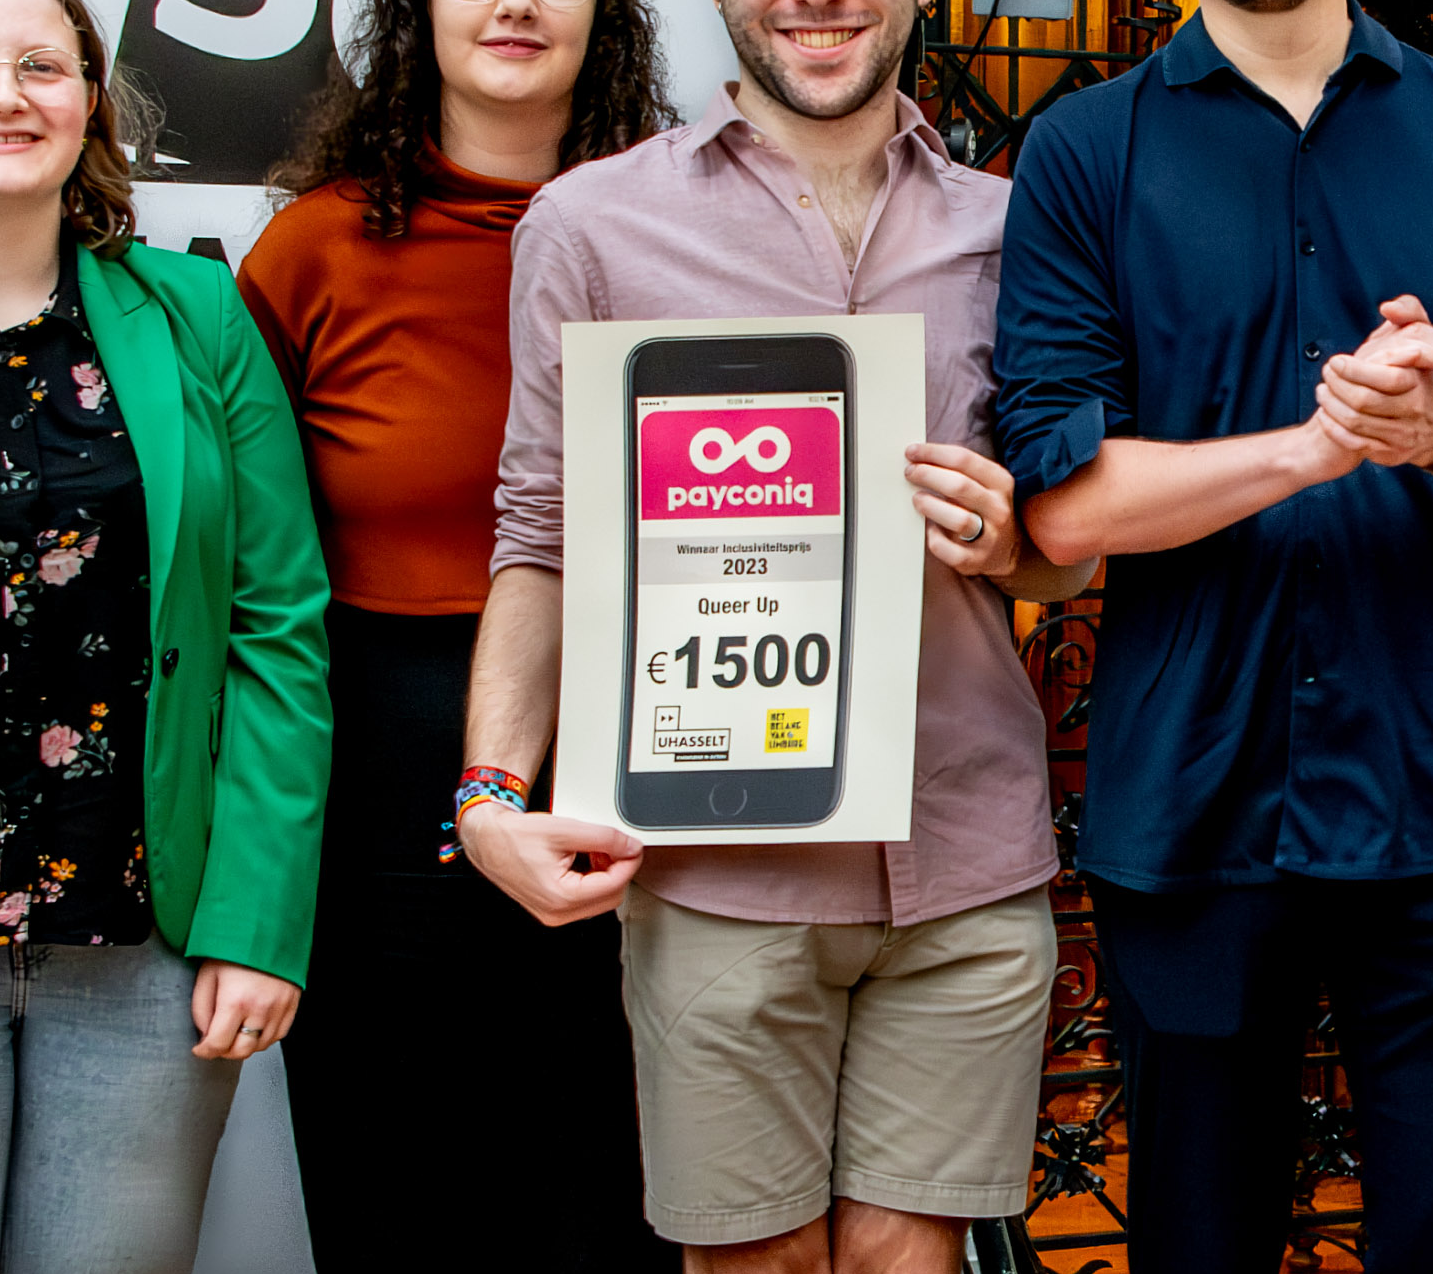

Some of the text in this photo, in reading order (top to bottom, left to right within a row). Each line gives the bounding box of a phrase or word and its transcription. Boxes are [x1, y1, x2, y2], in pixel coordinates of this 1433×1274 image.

[668, 476, 814, 511] payconiq
[677, 541, 812, 555] Winnaar Inclusiviteitsprijs
[723, 558, 768, 576] 2023
[698, 597, 779, 616] Queer Up
[647, 633, 831, 690] €1500
[658, 735, 726, 748] UHASSELT
